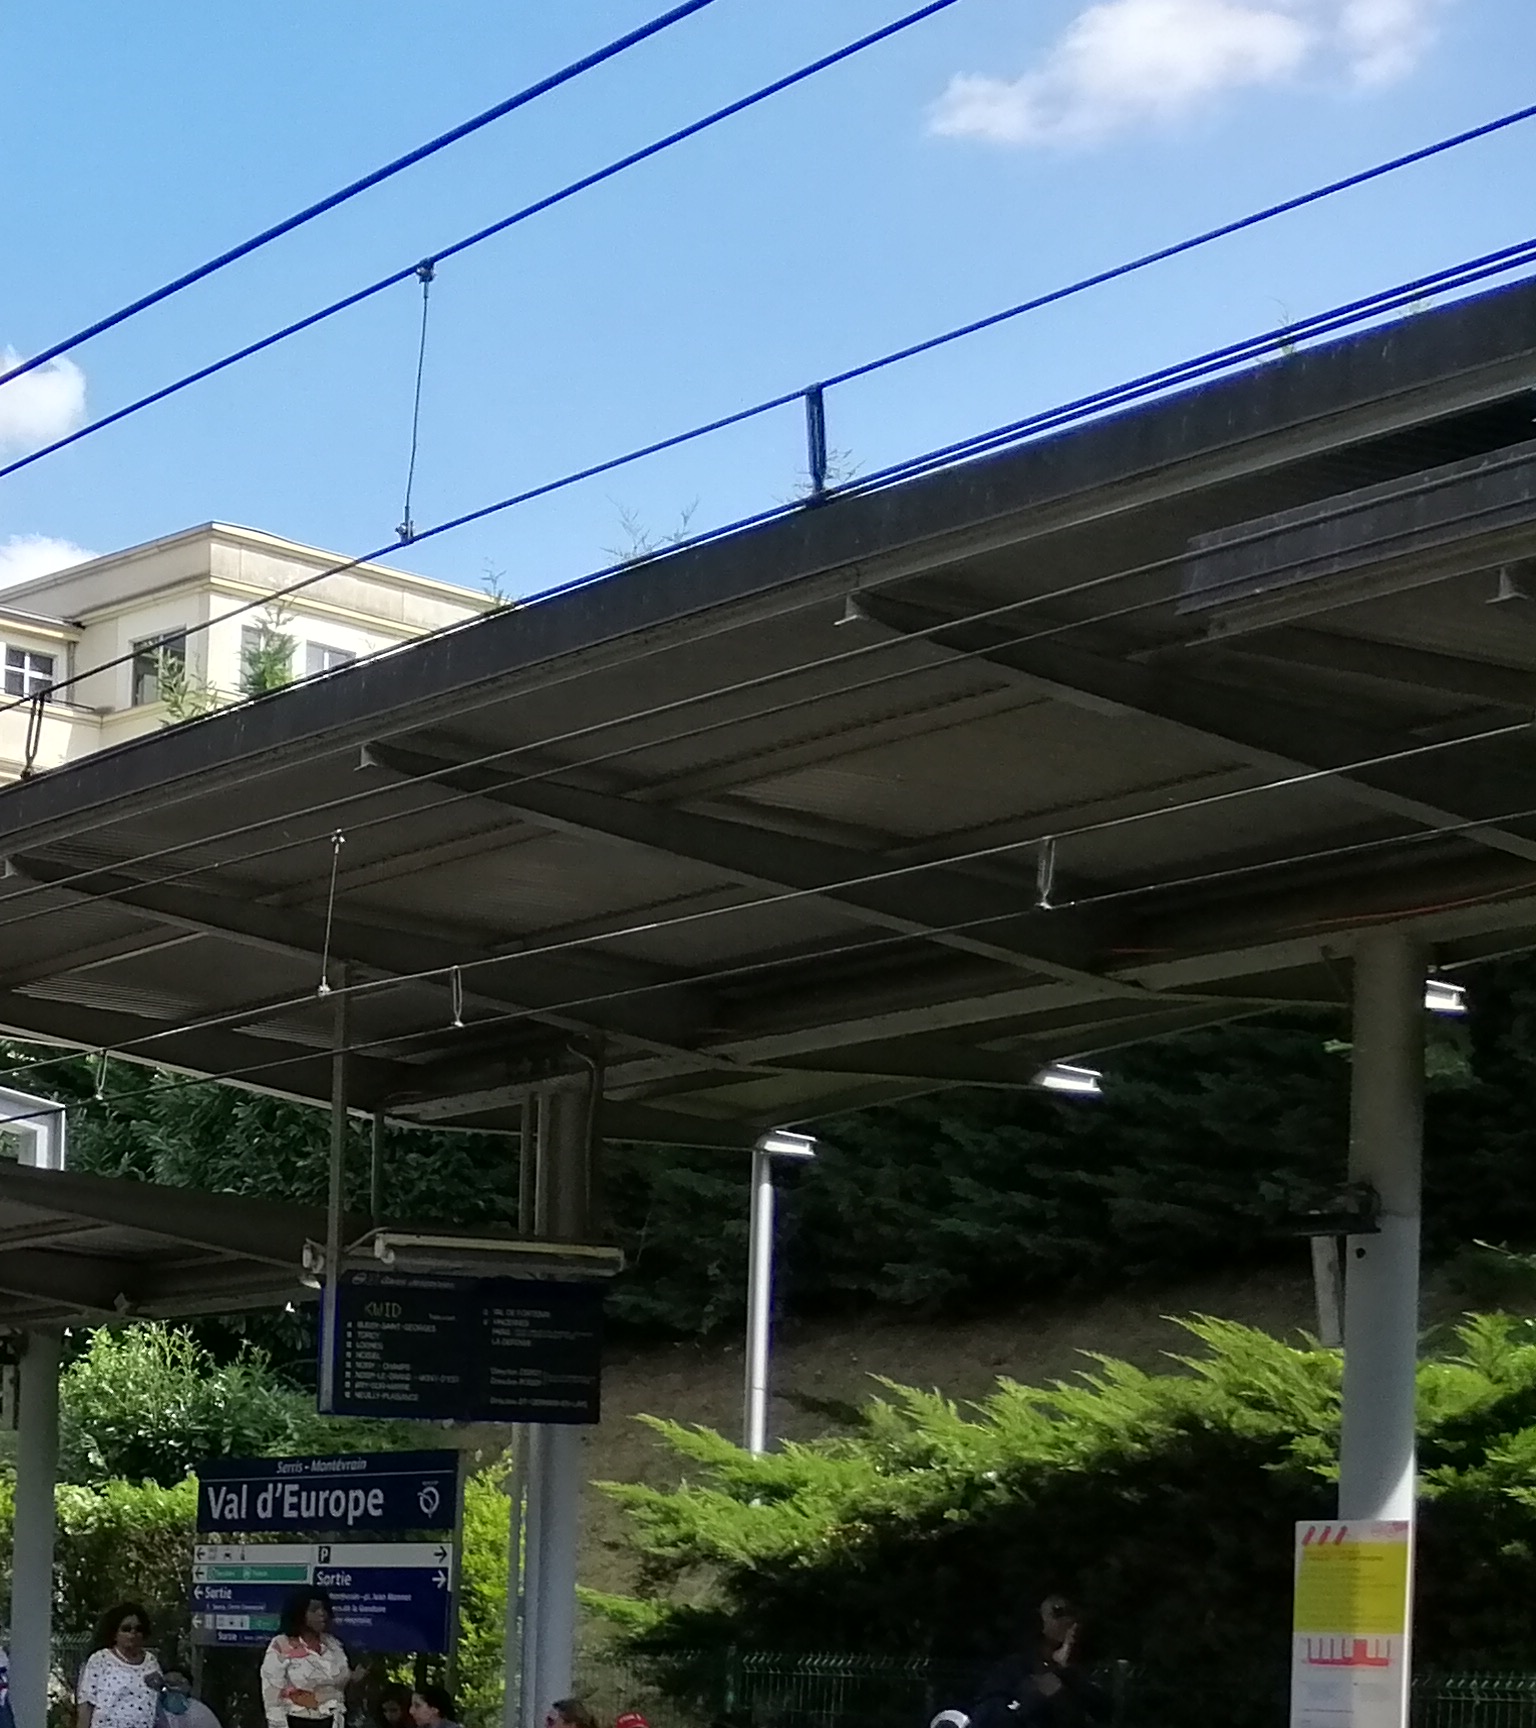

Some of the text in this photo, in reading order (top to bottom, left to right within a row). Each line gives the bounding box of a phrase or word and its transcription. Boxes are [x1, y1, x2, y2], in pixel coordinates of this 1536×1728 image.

[276, 1461, 303, 1474] Serris
[310, 1458, 367, 1473] Montévrain
[207, 1482, 385, 1526] Val d'Europe
[316, 1570, 353, 1586] Sortie
[205, 1586, 233, 1600] Sortie
